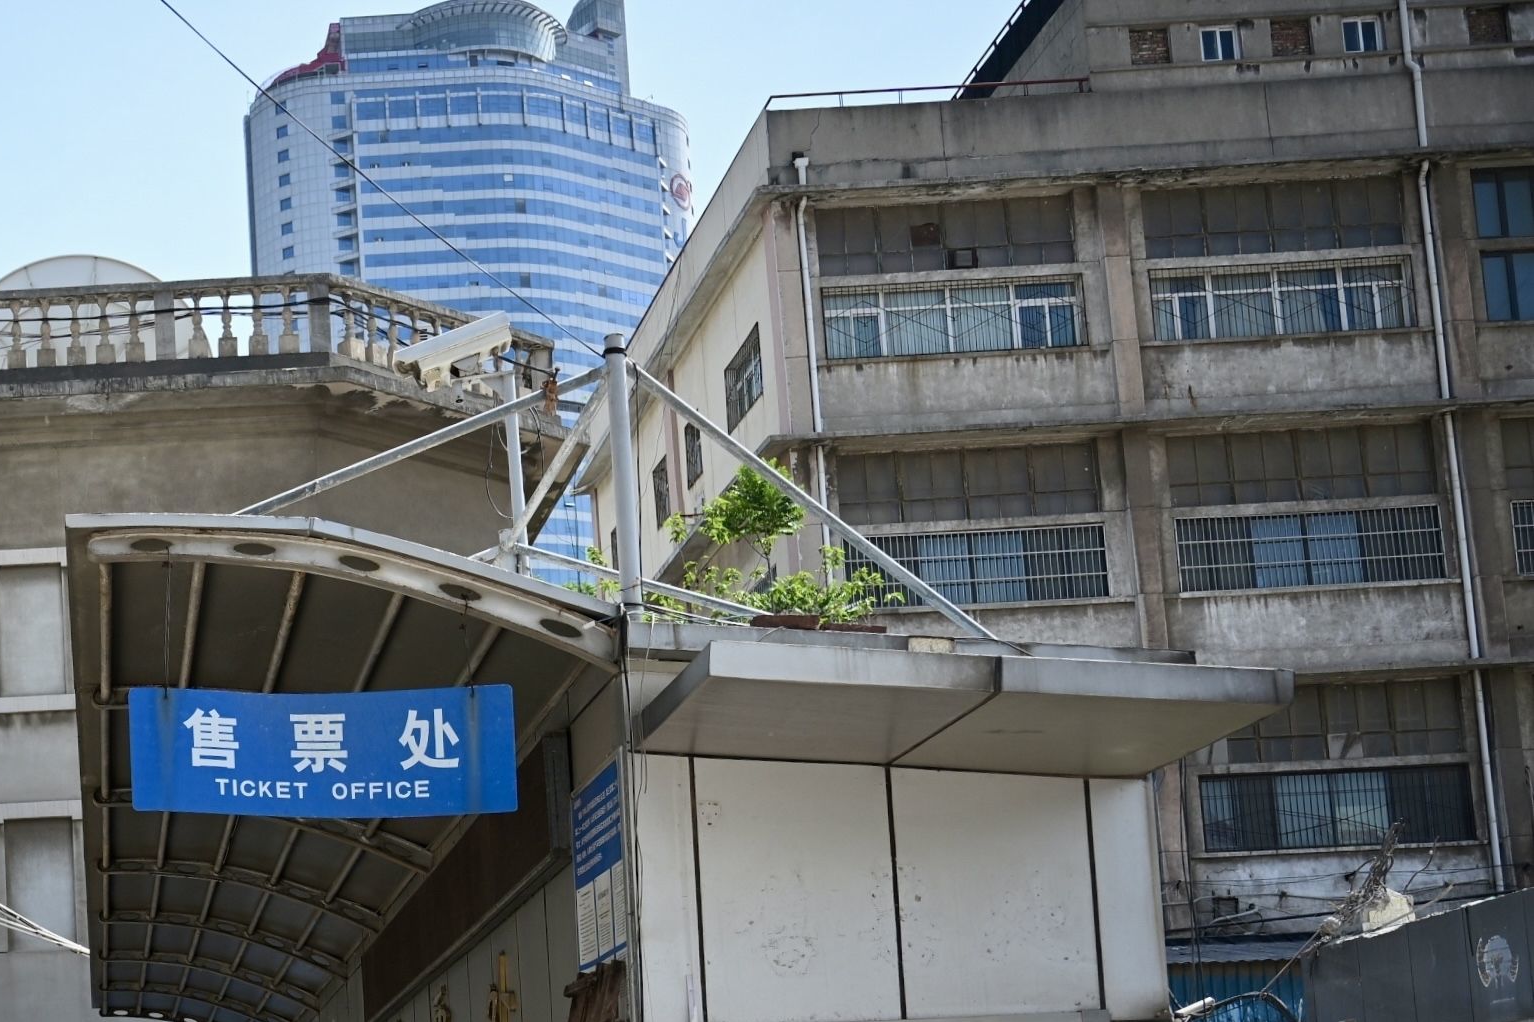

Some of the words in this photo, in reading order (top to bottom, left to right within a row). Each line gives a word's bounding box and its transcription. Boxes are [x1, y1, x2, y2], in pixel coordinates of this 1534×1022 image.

[183, 708, 461, 775] 售票处
[215, 778, 308, 799] TICKET
[332, 779, 430, 800] OFFICE
